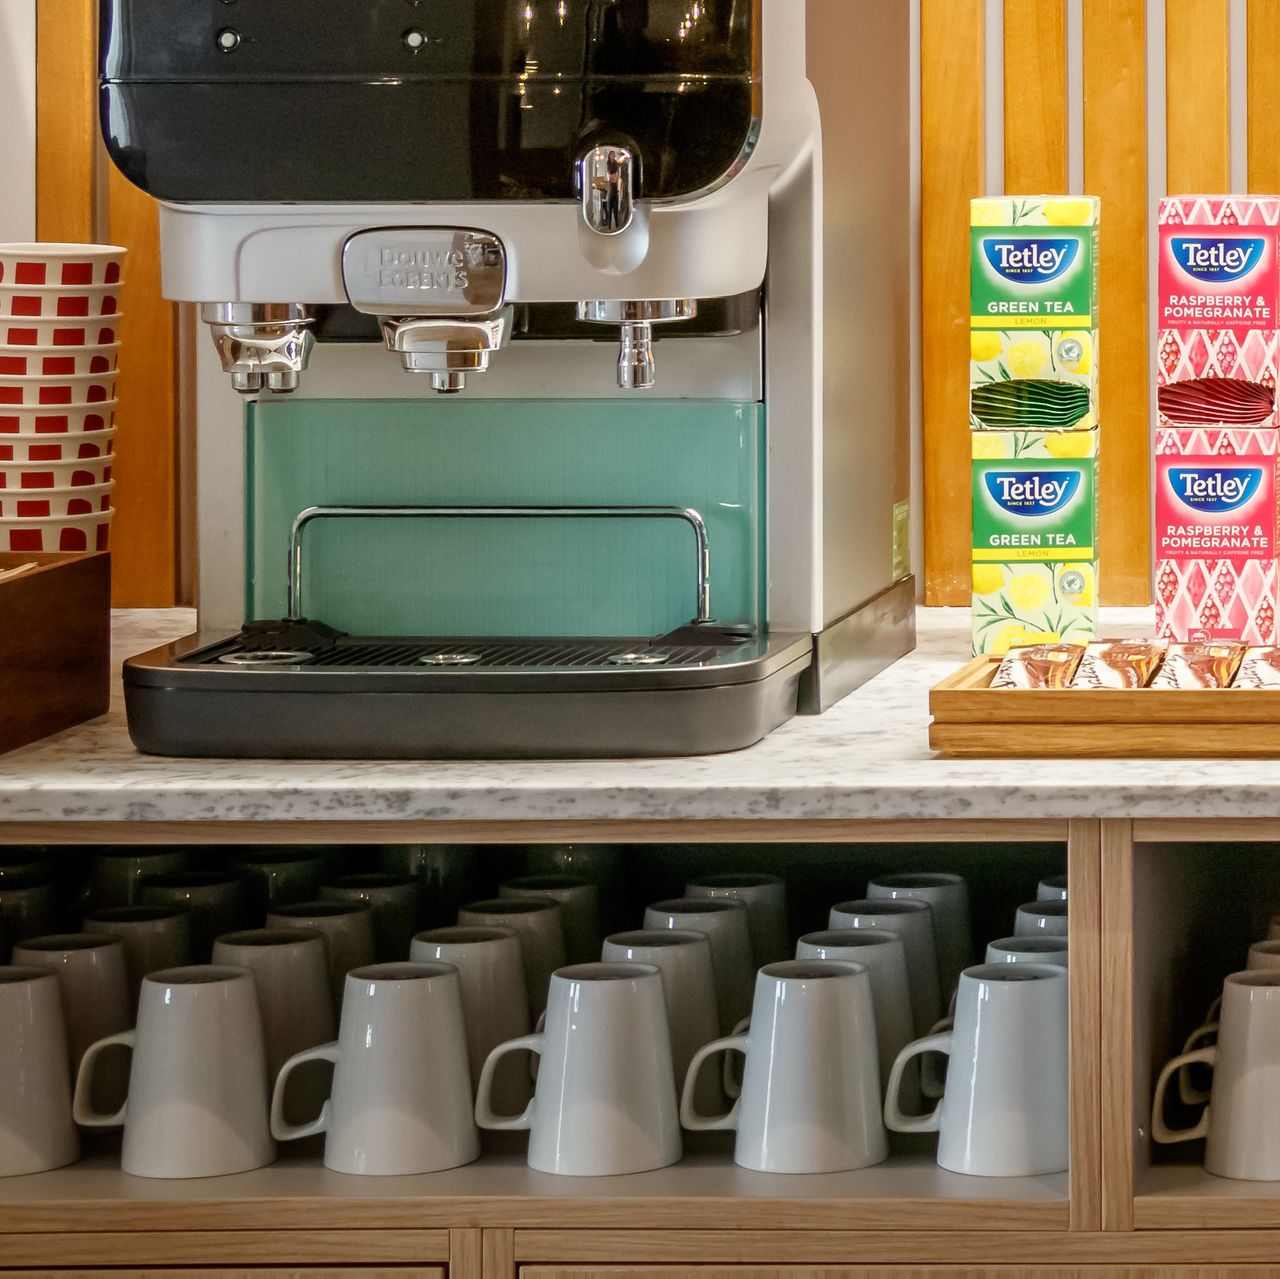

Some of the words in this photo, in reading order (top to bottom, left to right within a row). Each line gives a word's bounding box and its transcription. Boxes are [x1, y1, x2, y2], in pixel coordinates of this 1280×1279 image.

[994, 243, 1068, 274] Tetley
[1182, 243, 1254, 273] Tetley
[1169, 295, 1252, 306] RASPBERRY
[1255, 295, 1265, 306] &
[987, 301, 1039, 313] GREEN
[1044, 301, 1075, 313] TEA
[1163, 307, 1271, 318] POMEGRANATE
[1014, 317, 1047, 325] LEMON
[996, 476, 1069, 506] Tetley
[1179, 472, 1251, 503] Tetley
[1166, 525, 1250, 536] RASPBERRY
[1253, 525, 1263, 536] &
[989, 534, 1041, 546] GREEN
[1046, 533, 1077, 545] TEA
[1161, 537, 1268, 548] POMEGRANATE
